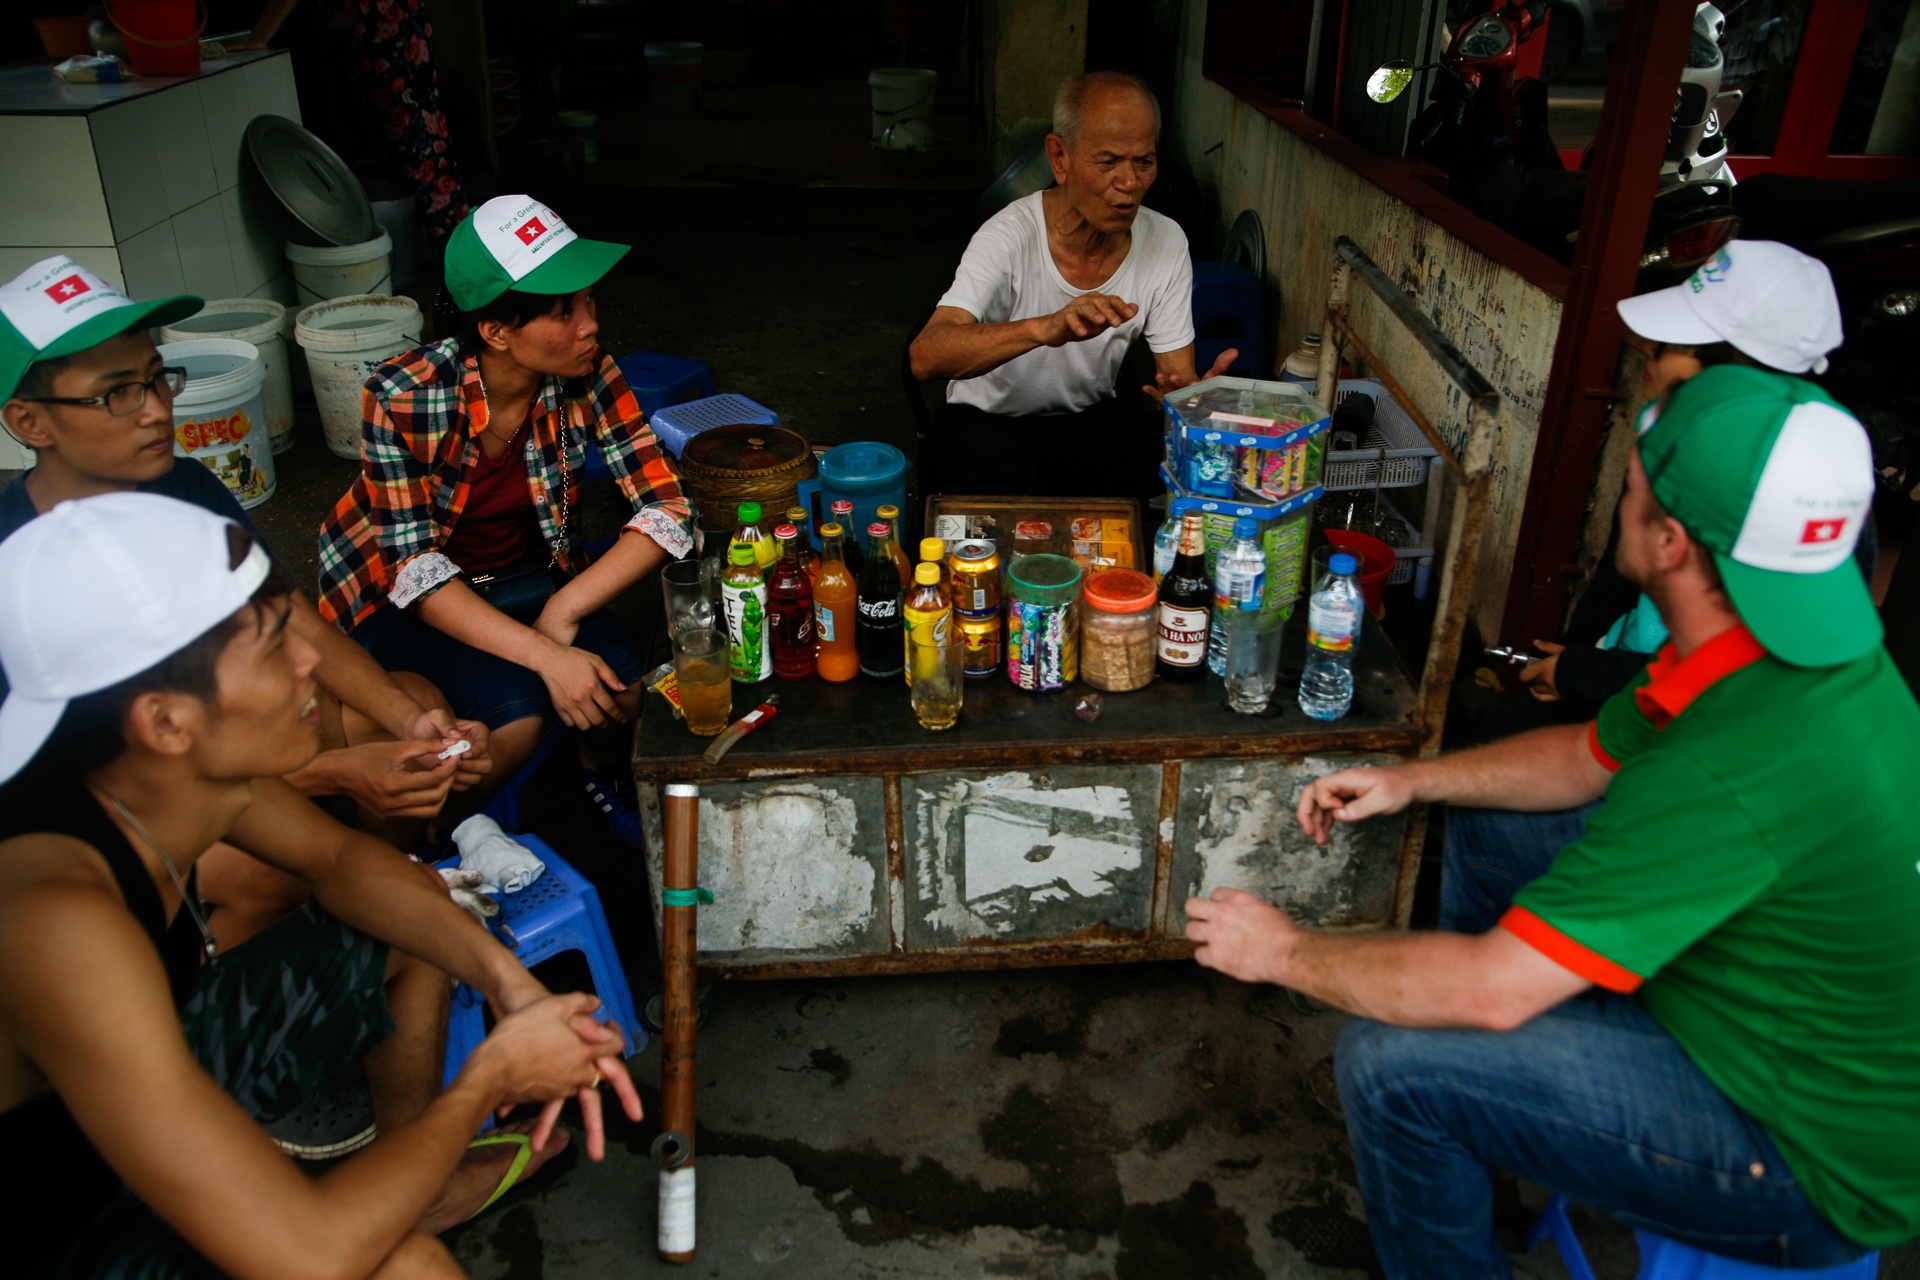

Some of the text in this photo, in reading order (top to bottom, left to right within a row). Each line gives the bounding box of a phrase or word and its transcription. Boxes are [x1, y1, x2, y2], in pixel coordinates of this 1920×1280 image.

[499, 221, 513, 233] For
[517, 201, 538, 218] Green
[25, 280, 43, 292] For
[51, 260, 77, 275] Gree
[183, 415, 244, 448] SPEC
